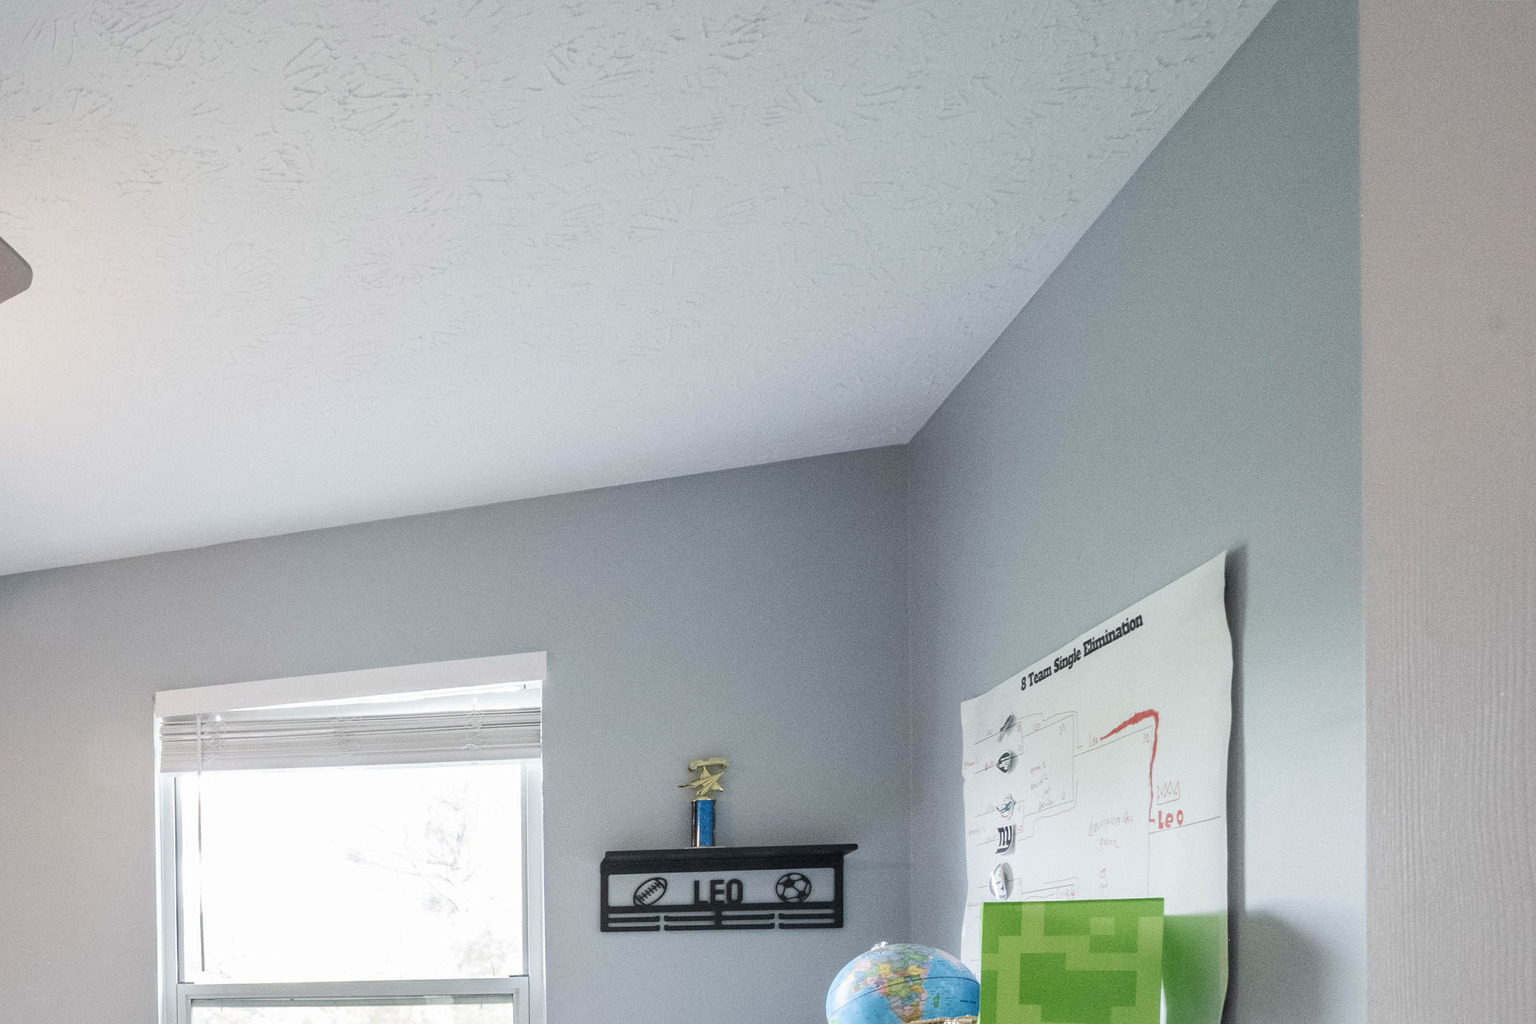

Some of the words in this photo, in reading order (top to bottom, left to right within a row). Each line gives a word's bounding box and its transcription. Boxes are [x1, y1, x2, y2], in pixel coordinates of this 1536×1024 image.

[1021, 677, 1027, 691] 8
[1028, 666, 1052, 687] Team
[1053, 648, 1081, 674] Single
[1083, 615, 1144, 657] Elimination
[693, 879, 744, 904] LEO
